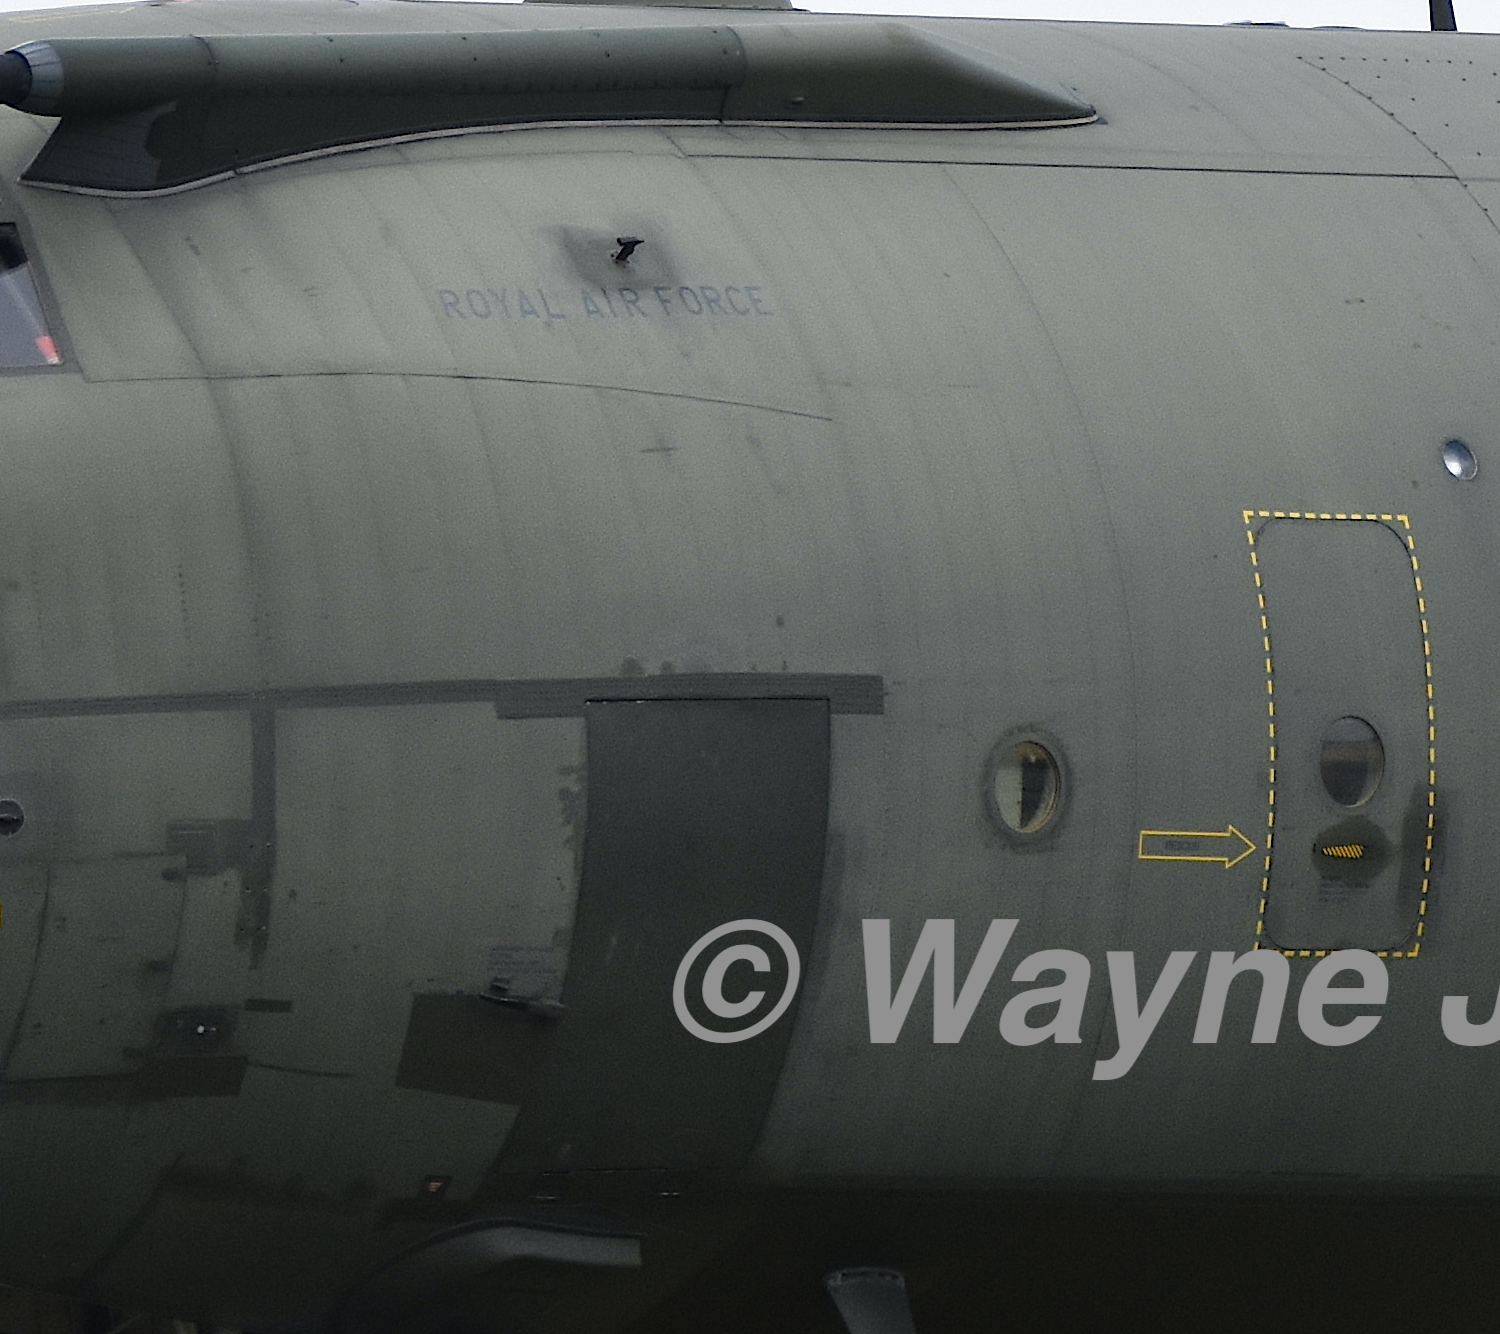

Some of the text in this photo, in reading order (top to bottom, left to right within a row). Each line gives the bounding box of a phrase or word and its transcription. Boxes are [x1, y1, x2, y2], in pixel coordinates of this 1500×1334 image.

[437, 285, 774, 320] ROYAL AIR FORCE
